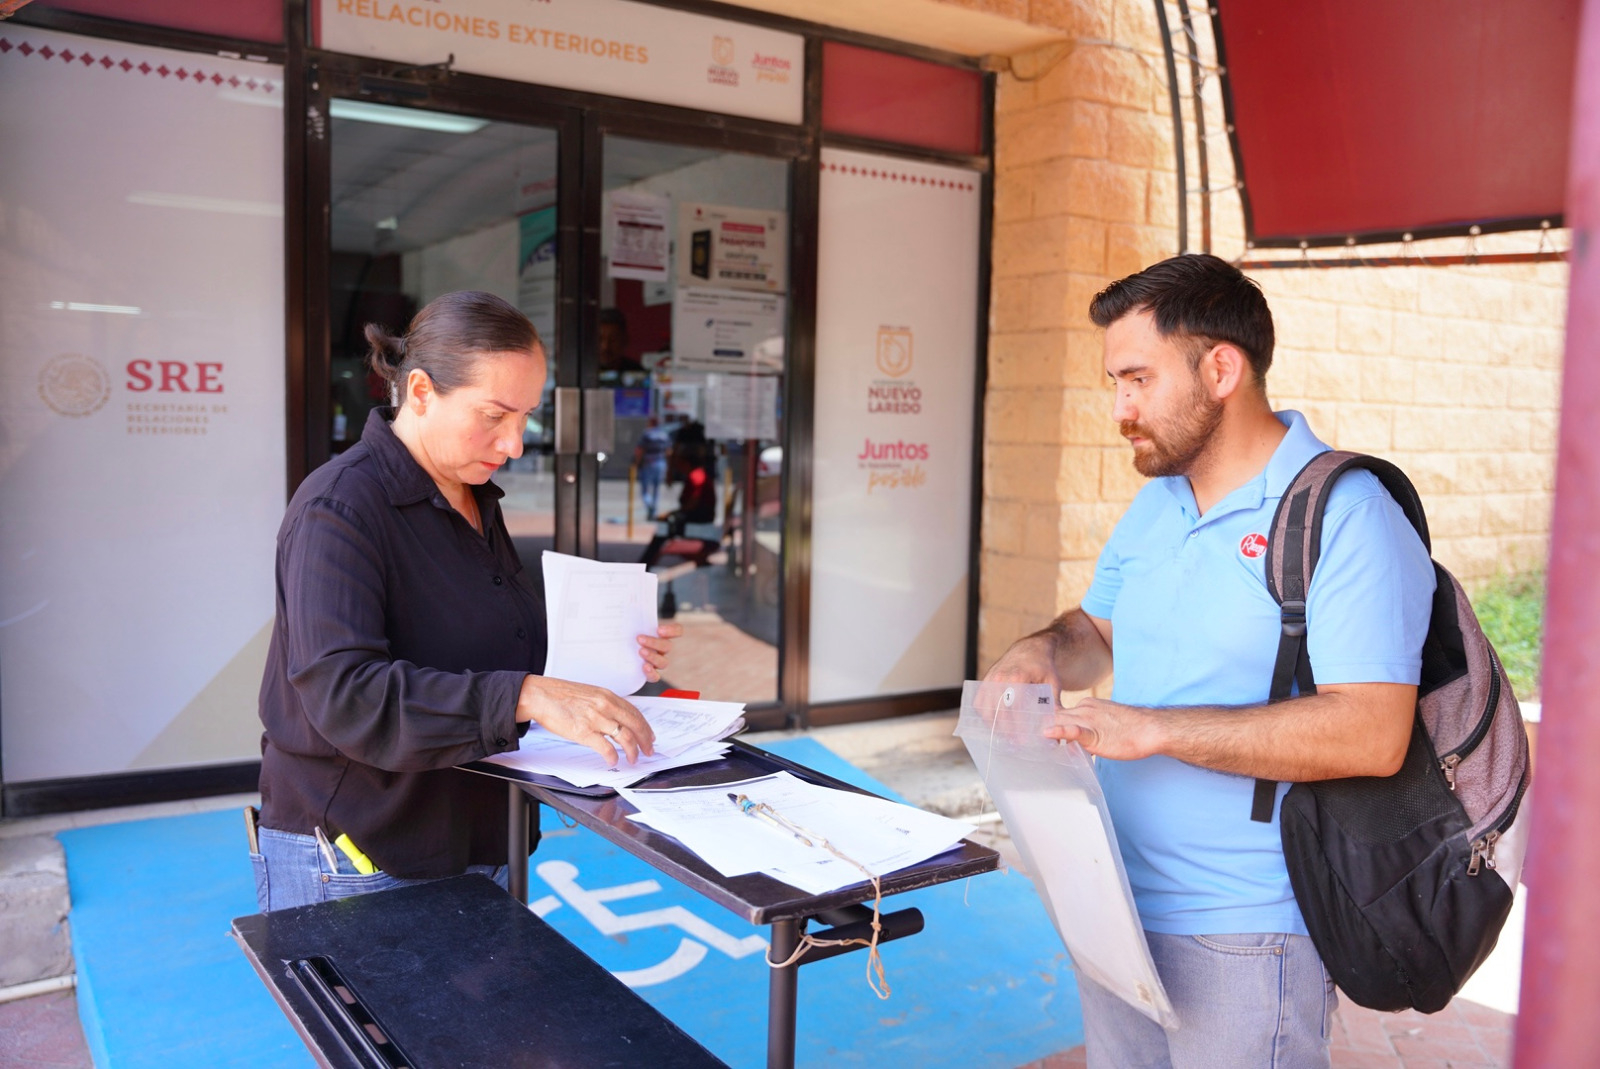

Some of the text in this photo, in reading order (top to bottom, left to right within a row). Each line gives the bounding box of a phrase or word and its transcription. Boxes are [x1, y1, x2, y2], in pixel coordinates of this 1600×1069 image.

[337, 0, 649, 64] RELACIONES EXTERIORES
[126, 359, 224, 393] SRE
[868, 387, 922, 401] NUEVO
[212, 404, 228, 413] DE
[868, 401, 922, 414] LAREDO
[126, 414, 209, 424] RELACIONES
[126, 425, 208, 435] EXTERIORES
[858, 437, 929, 461] Juntos
